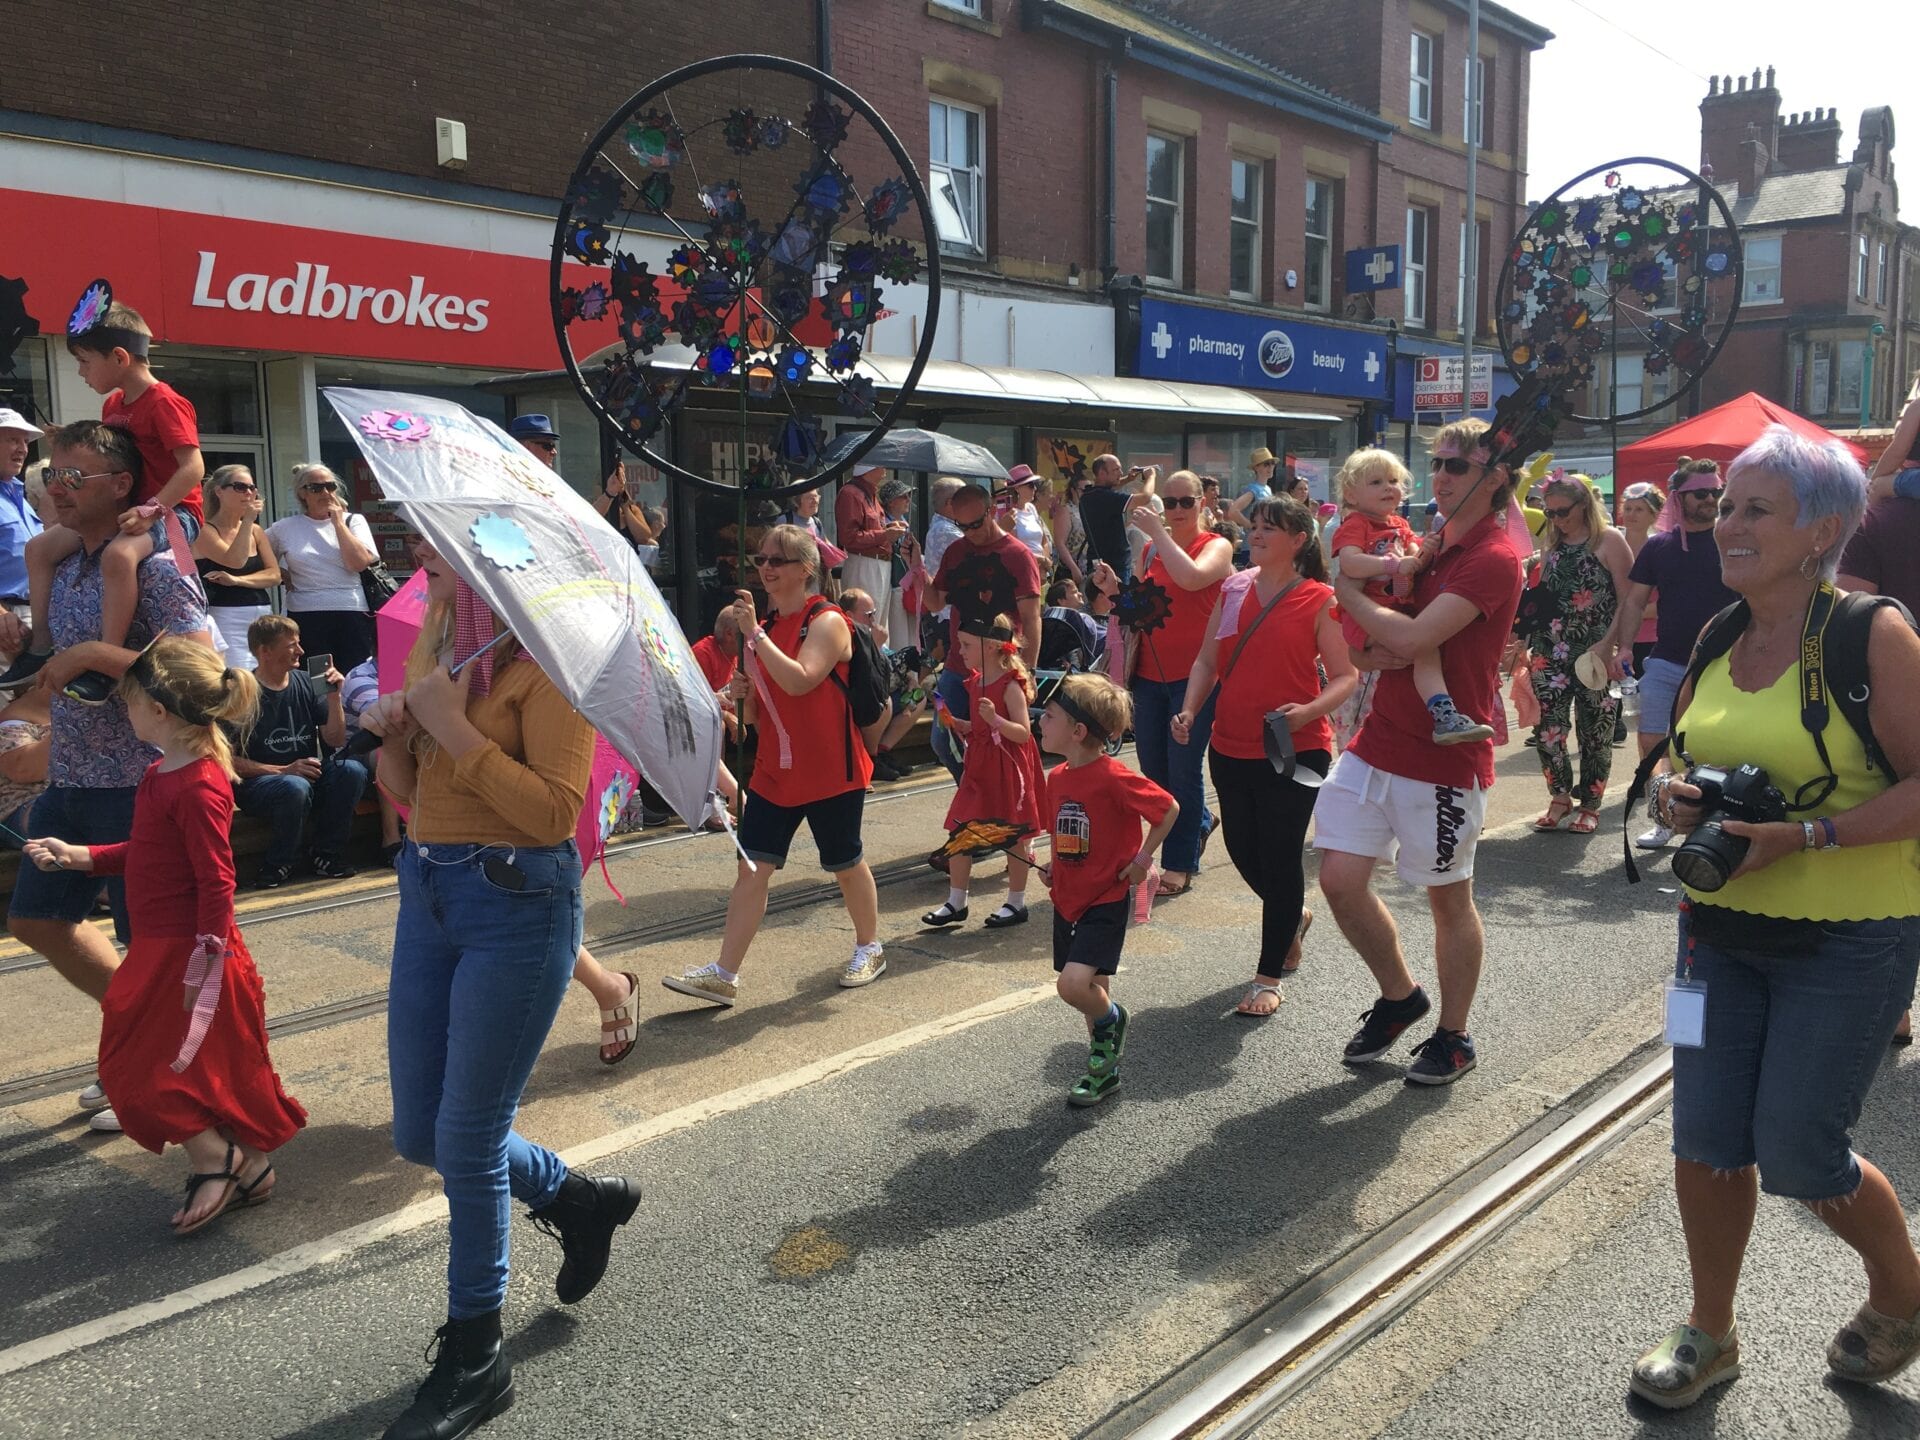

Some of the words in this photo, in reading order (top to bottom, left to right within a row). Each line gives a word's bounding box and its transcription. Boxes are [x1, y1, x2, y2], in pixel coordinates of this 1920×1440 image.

[192, 250, 490, 332] Ladbrokes
[1189, 334, 1245, 361] pharmacy
[1266, 342, 1294, 364] Boots
[1312, 351, 1345, 373] beauty
[1445, 365, 1487, 374] Avable
[1416, 394, 1438, 404] 0161
[1442, 393, 1459, 403] 631
[1805, 635, 1820, 671] D850
[1810, 672, 1819, 701] Nikon
